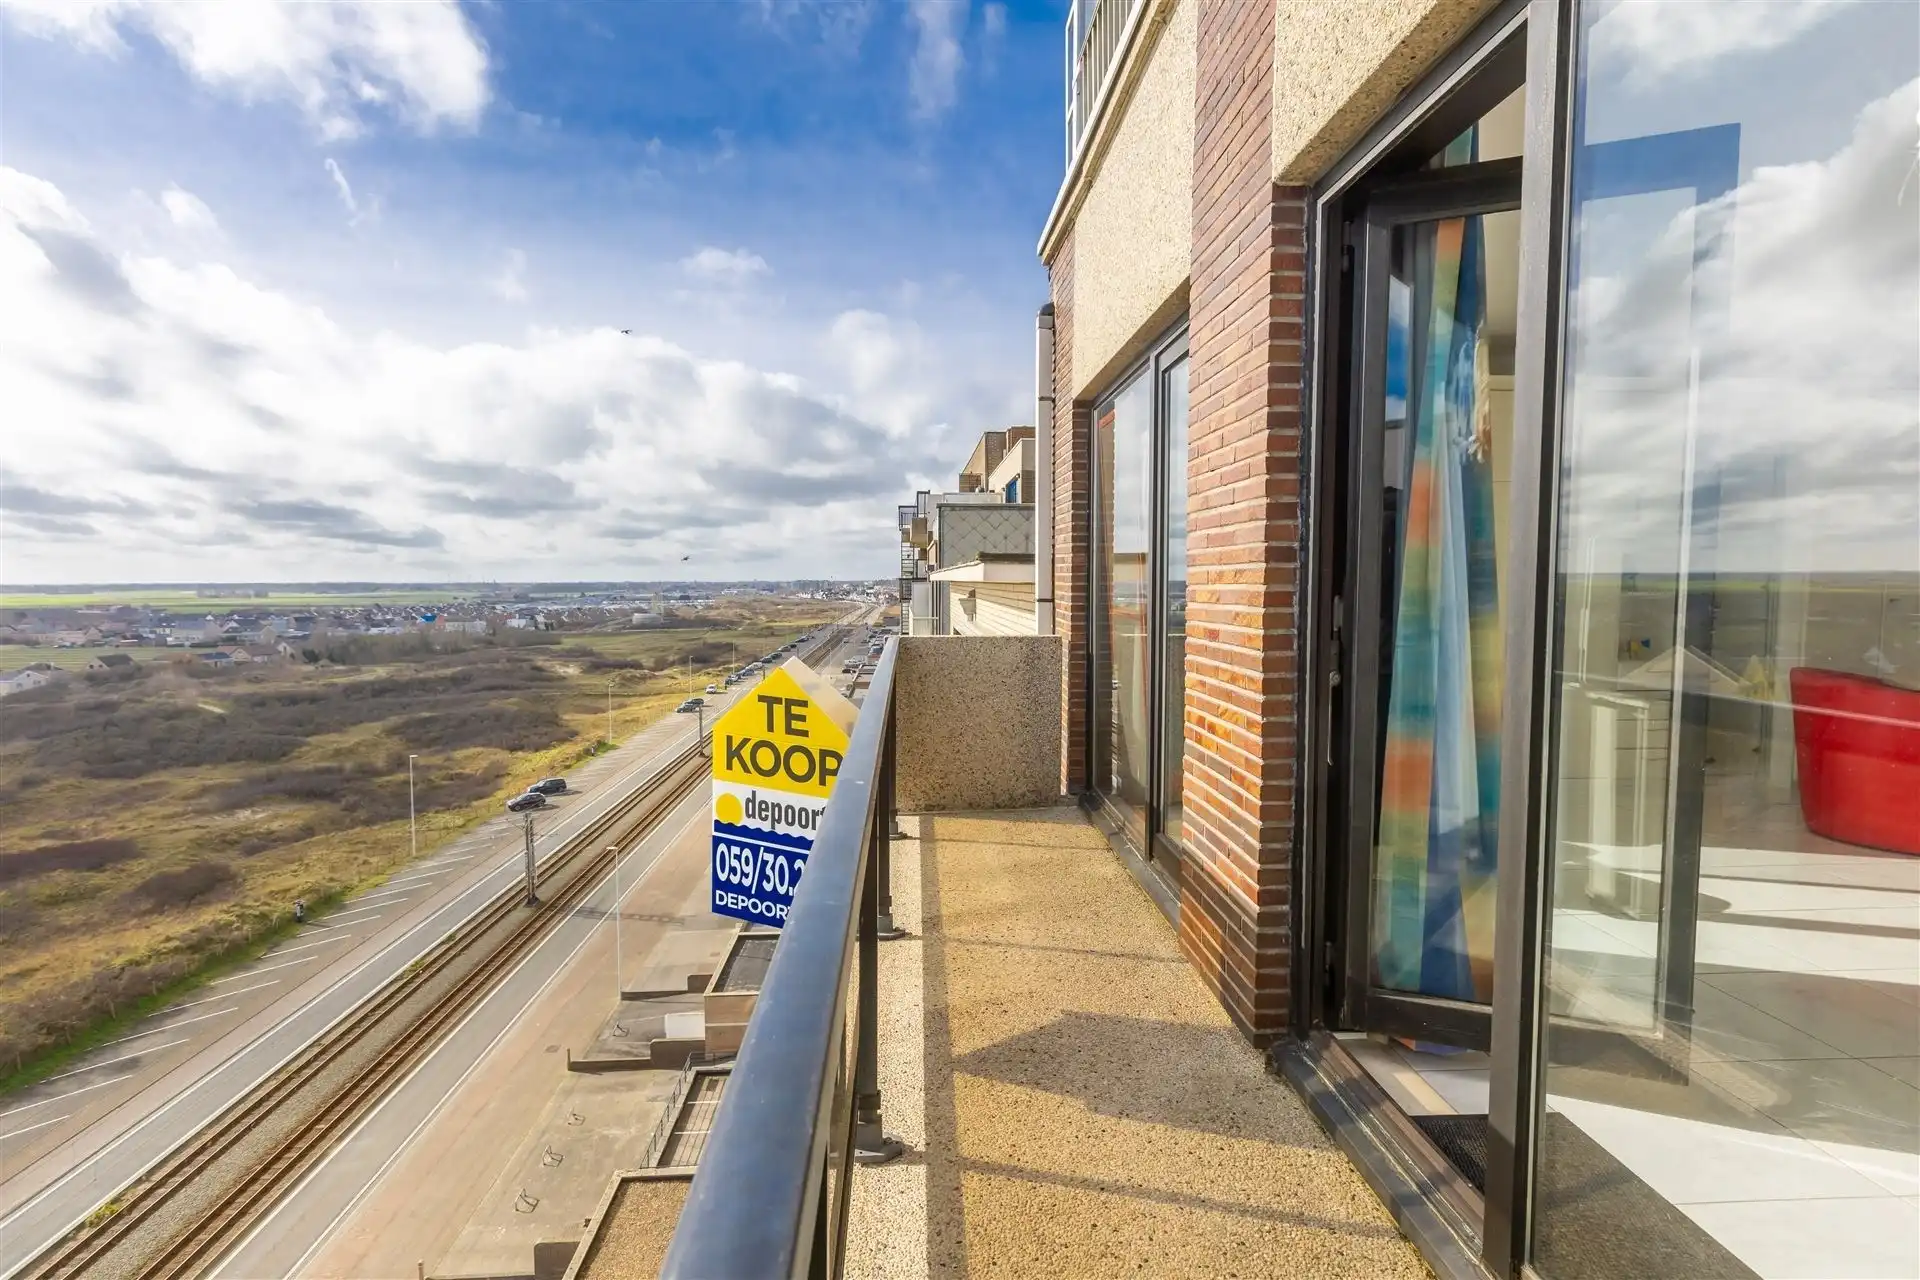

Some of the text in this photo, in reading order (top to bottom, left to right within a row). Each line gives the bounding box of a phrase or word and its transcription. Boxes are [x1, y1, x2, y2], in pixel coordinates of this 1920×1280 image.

[757, 694, 809, 737] TE
[726, 735, 844, 787] KOOP
[716, 890, 791, 920] DEPOOR
